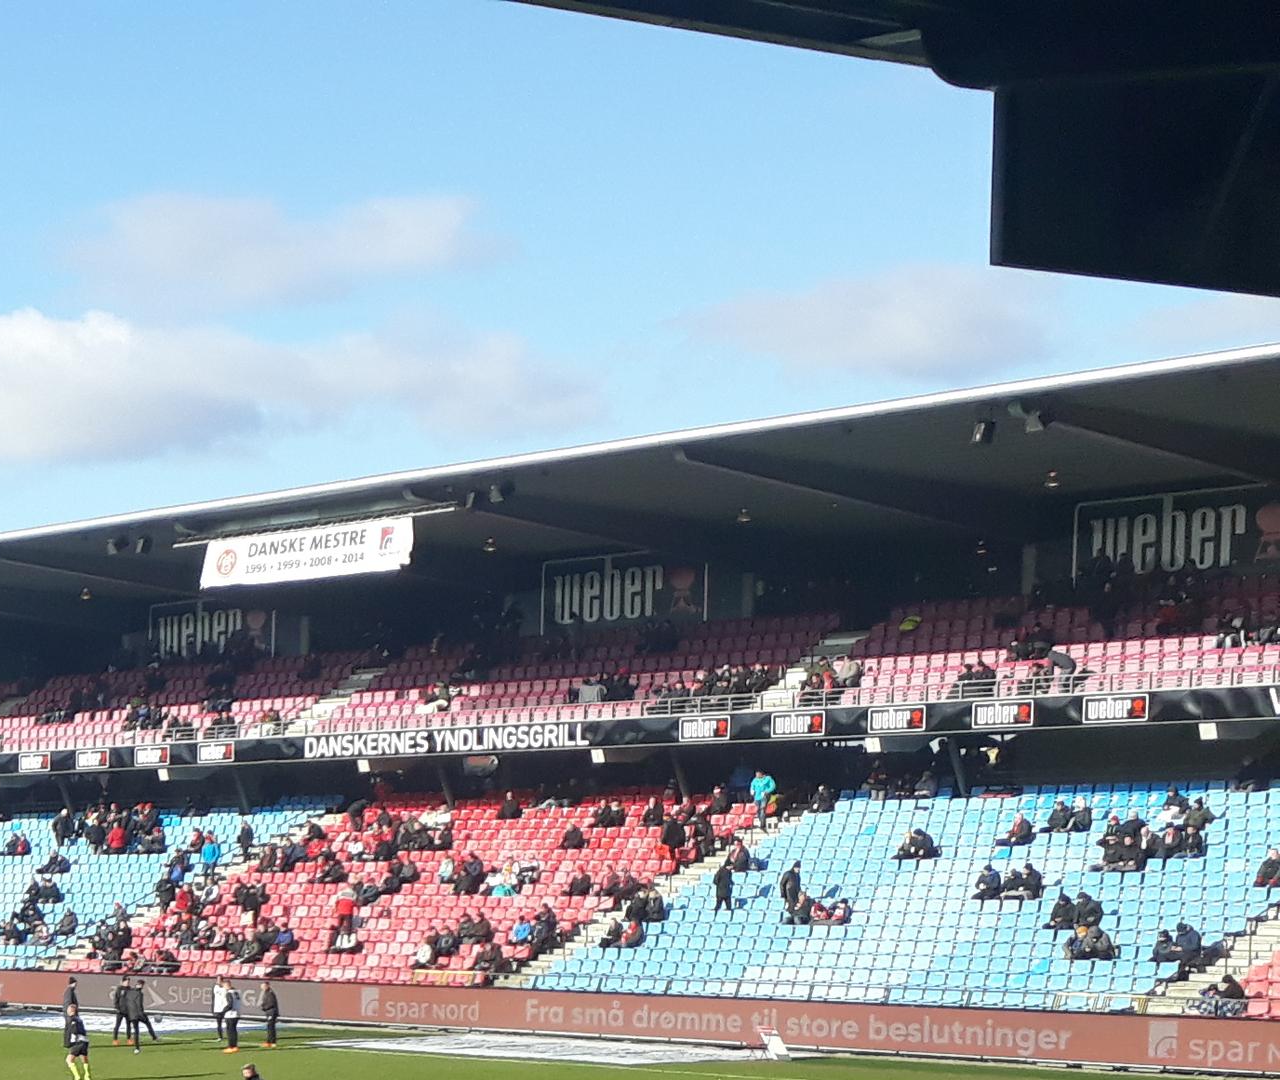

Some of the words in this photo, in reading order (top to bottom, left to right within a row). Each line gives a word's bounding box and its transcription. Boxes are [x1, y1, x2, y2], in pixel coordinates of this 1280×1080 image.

[248, 536, 305, 558] DANSKE
[310, 529, 367, 552] MESTRE
[1091, 495, 1247, 574] weber
[278, 559, 301, 571] 1999
[310, 555, 333, 568] 2008
[342, 552, 365, 564] 2014
[554, 556, 664, 625] weber
[871, 709, 911, 729] weber
[976, 702, 1018, 724] weber
[1088, 698, 1131, 720] weber
[683, 718, 717, 738] weber
[775, 714, 811, 734] weber
[304, 731, 428, 758] DANSKERNES
[433, 724, 590, 751] YNDLINGSGRILL
[385, 1000, 428, 1021] spar
[433, 1000, 479, 1021] Nord
[526, 999, 564, 1023] Fra
[571, 1000, 624, 1027] små
[632, 1004, 742, 1032] drømme
[786, 1015, 859, 1040] store
[868, 1013, 1073, 1057] beslutninger
[1188, 1039, 1261, 1067] spar
